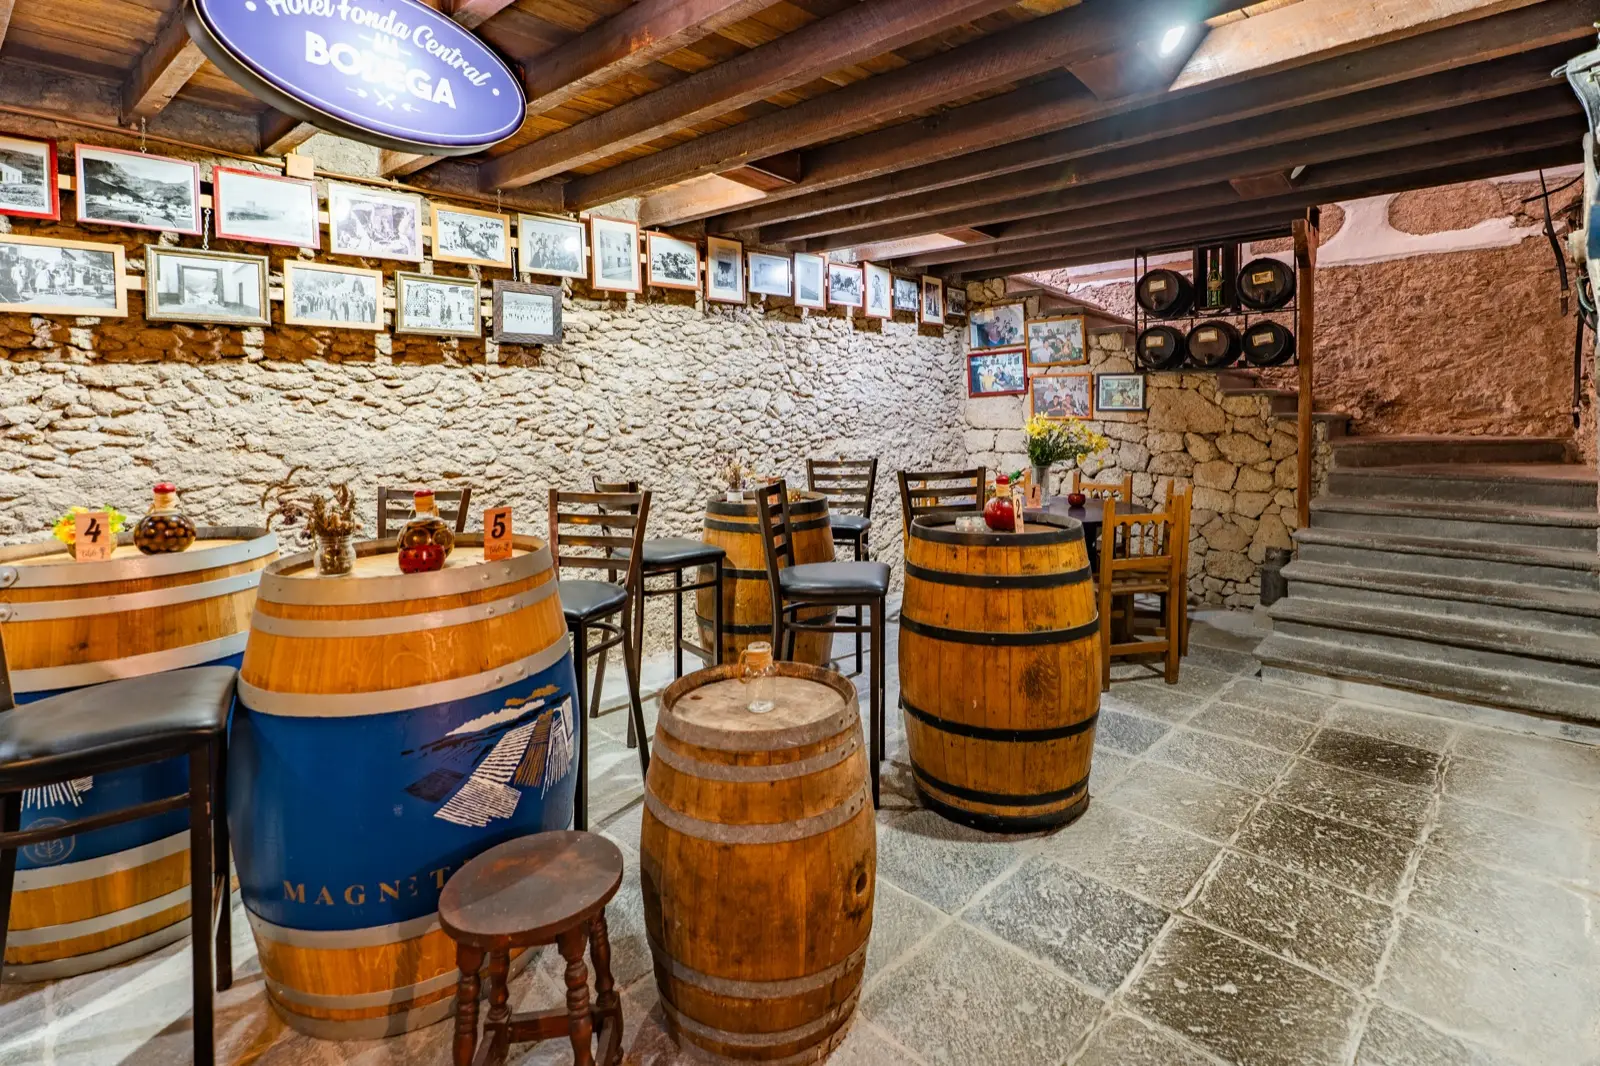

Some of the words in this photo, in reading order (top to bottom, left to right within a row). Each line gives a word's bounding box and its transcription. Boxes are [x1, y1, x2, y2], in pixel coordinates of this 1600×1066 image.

[305, 30, 457, 109] BODEGA
[413, 25, 492, 87] Central
[1015, 499, 1021, 519] 2
[84, 518, 101, 543] 4
[491, 512, 507, 539] 5
